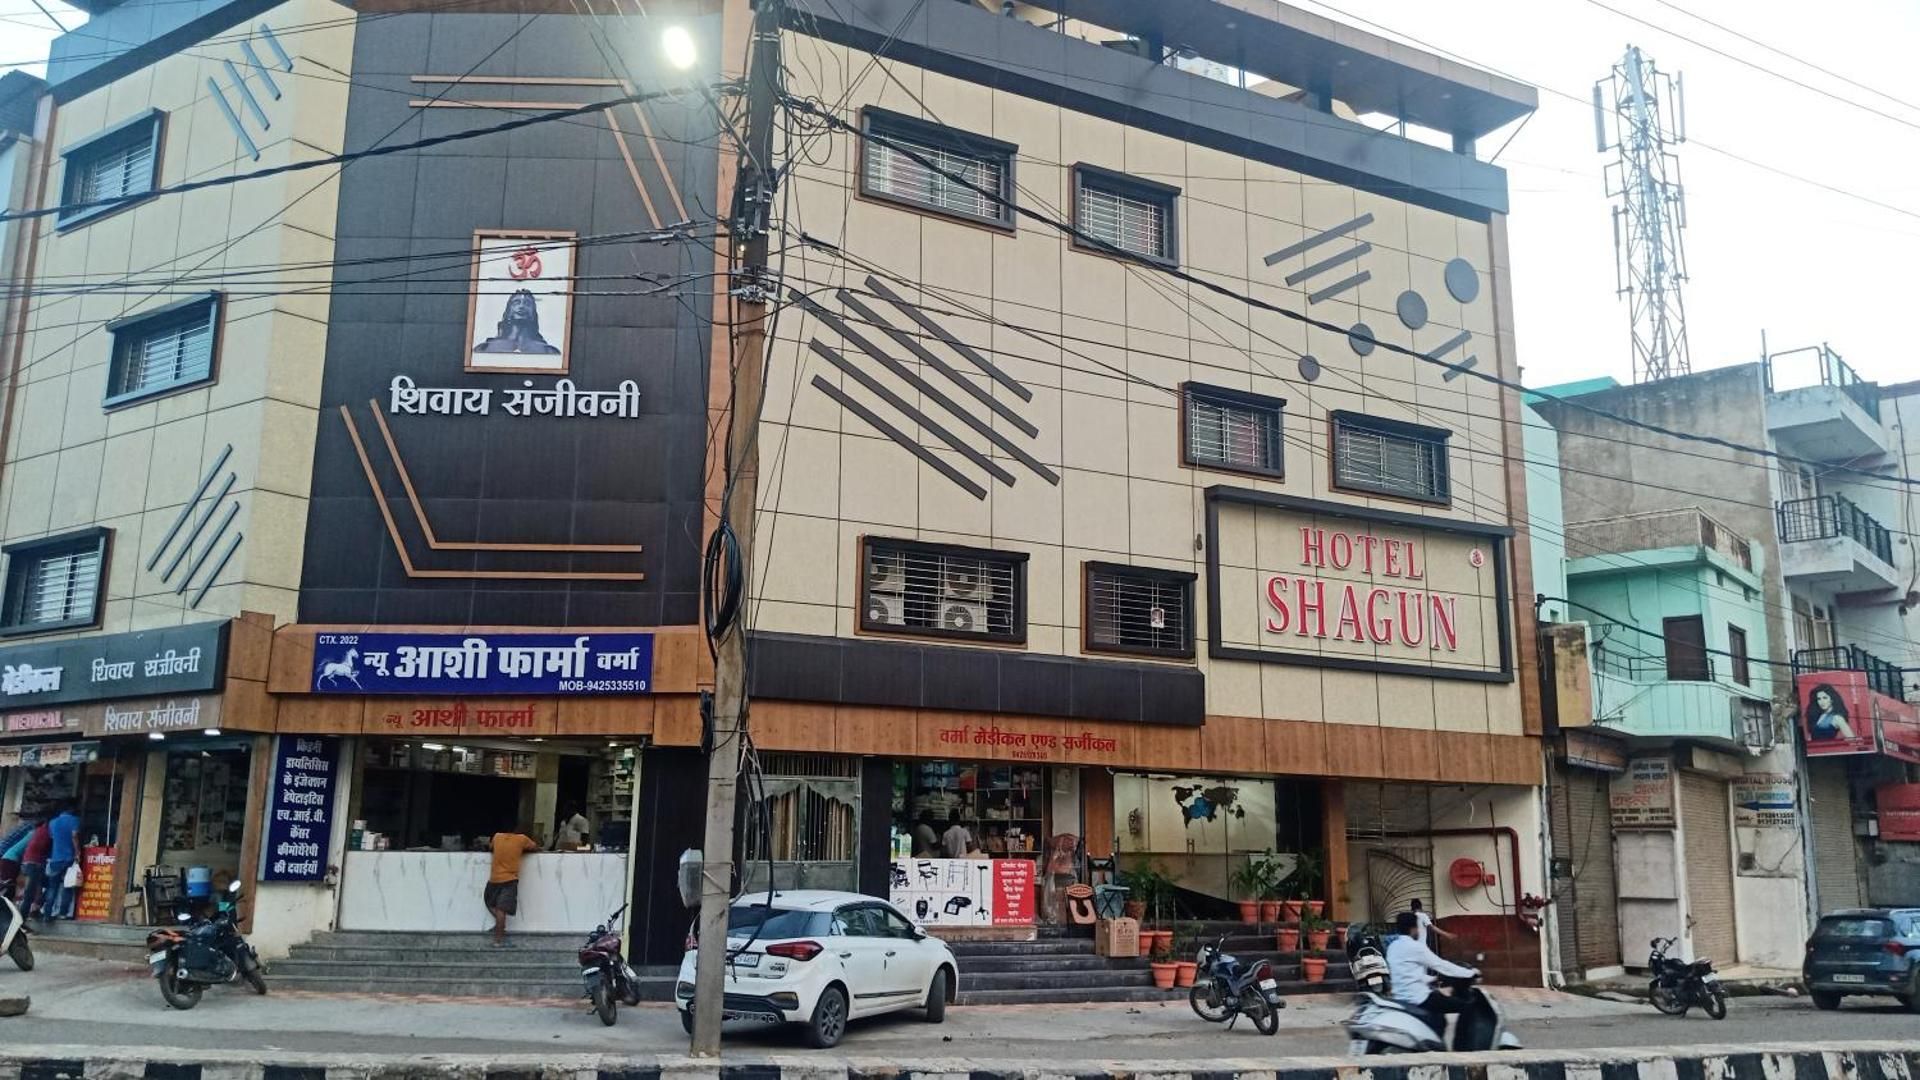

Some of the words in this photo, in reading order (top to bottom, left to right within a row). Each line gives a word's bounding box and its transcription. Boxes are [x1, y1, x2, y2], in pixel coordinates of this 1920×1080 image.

[390, 375, 493, 416] शिवाय
[502, 379, 640, 418] संजीवनी
[1300, 527, 1424, 580] HOTEL
[1266, 576, 1458, 651] SHAGUN
[340, 635, 359, 645] 2022
[91, 658, 136, 682] शिवाय
[144, 647, 200, 677] संजीवनी
[364, 652, 390, 676] न्यू
[394, 638, 492, 678] आशी
[498, 636, 590, 678] फार्मा
[597, 647, 640, 670] वर्मा
[559, 680, 646, 691] MOB-9425335510
[104, 706, 144, 731] शिवाय
[146, 699, 200, 728] संजीवनी
[411, 702, 468, 727] आशी
[477, 703, 537, 728] फार्मा
[939, 725, 969, 745] वर्मा
[974, 727, 1026, 748] मेडीकल
